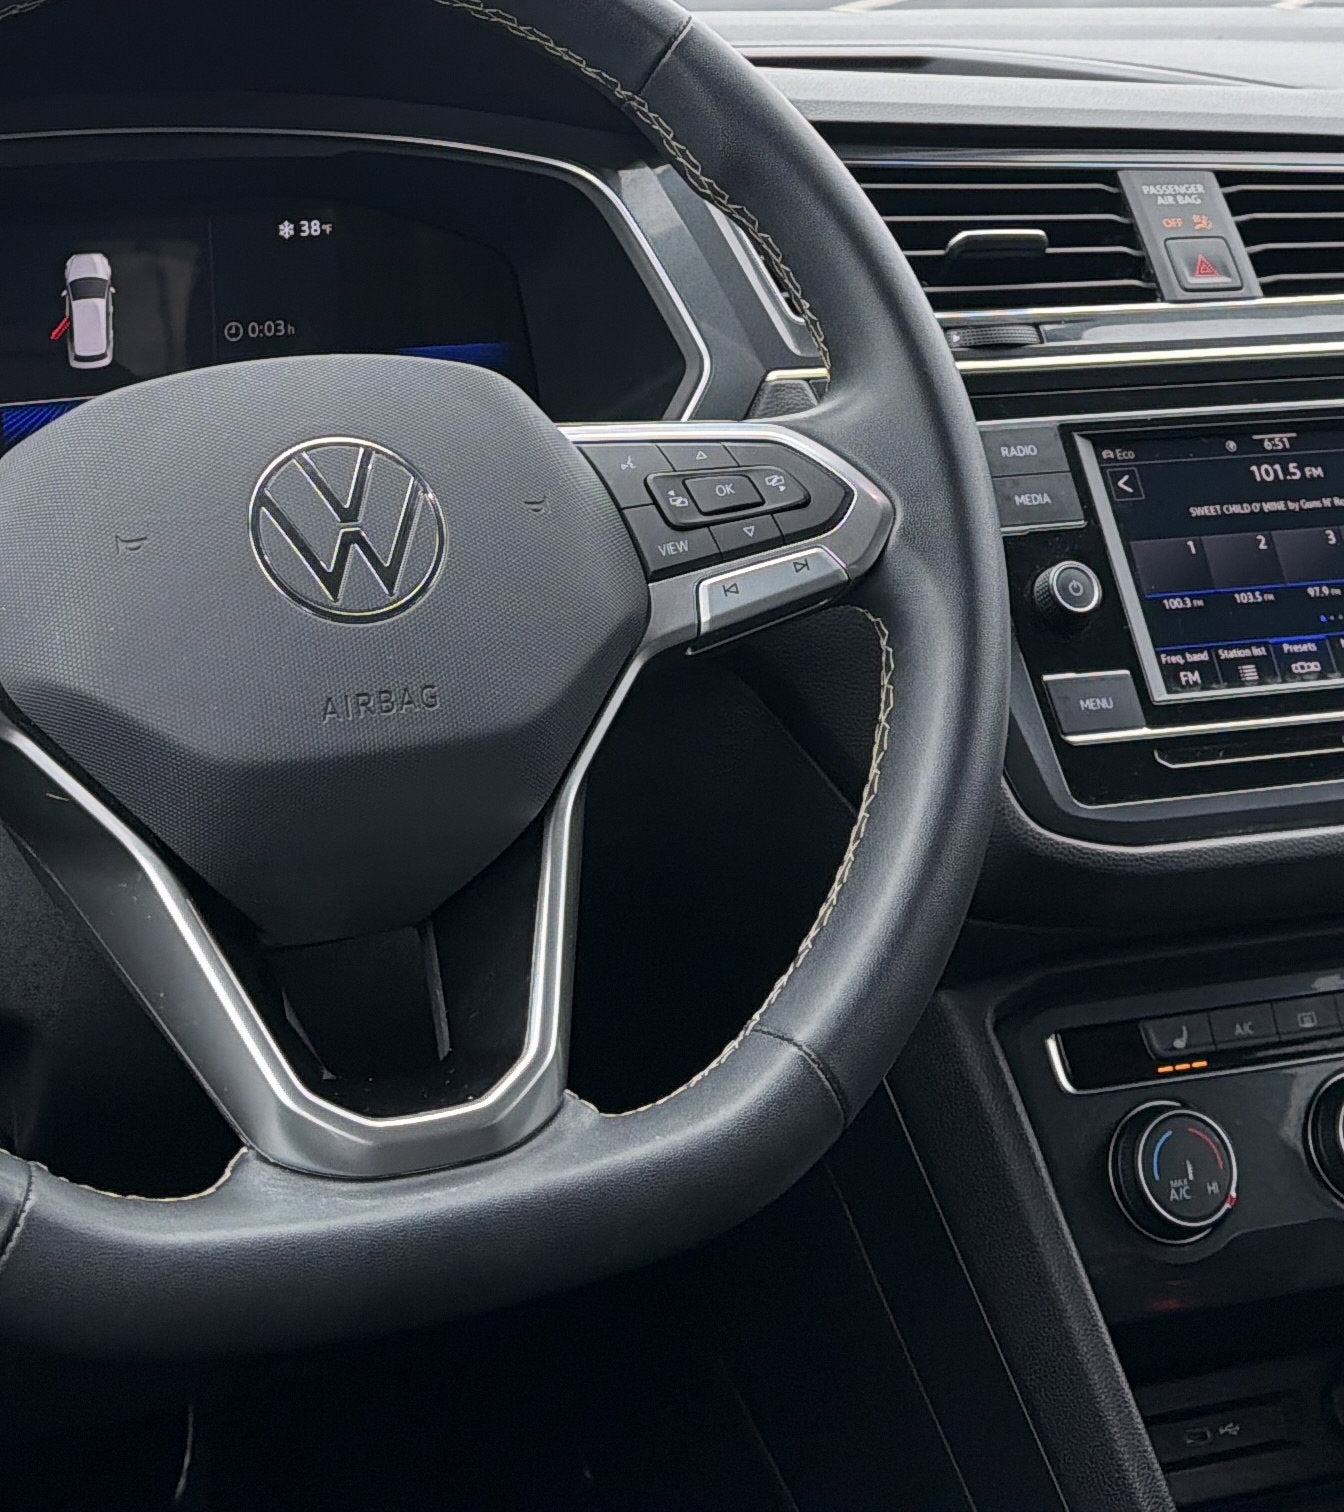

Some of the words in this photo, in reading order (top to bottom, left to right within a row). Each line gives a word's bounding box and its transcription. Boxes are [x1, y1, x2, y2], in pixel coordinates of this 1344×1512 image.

[1142, 183, 1206, 195] PASSENGER
[1157, 195, 1175, 205] AIR
[1176, 194, 1202, 205] BAG
[1162, 217, 1184, 229] OFF
[247, 320, 286, 339] 0:03
[1000, 444, 1038, 458] RADIO
[1263, 437, 1291, 451] 6:51
[1116, 448, 1136, 461] Eco
[1249, 463, 1302, 483] 101.5
[1304, 466, 1325, 479] FM
[715, 482, 736, 497] OK
[1014, 492, 1052, 506] MEDIA
[1189, 505, 1222, 517] SWEET
[1223, 502, 1252, 515] CHILD
[658, 540, 689, 557] VIEW
[1187, 540, 1197, 554] 1
[1256, 535, 1268, 550] 2
[1325, 530, 1337, 545] 3
[1234, 592, 1263, 604] 103.5
[1307, 586, 1330, 598] 97.9
[1162, 597, 1192, 610] 100.3
[1218, 648, 1251, 659] Station
[1251, 646, 1268, 657] list
[1282, 643, 1318, 654] Presets
[1185, 650, 1210, 662] band
[1179, 670, 1202, 686] FM
[322, 684, 441, 724] AIRBAG
[1079, 697, 1114, 711] MENU
[1234, 1022, 1256, 1036] A/C
[1169, 1186, 1192, 1201] A/C
